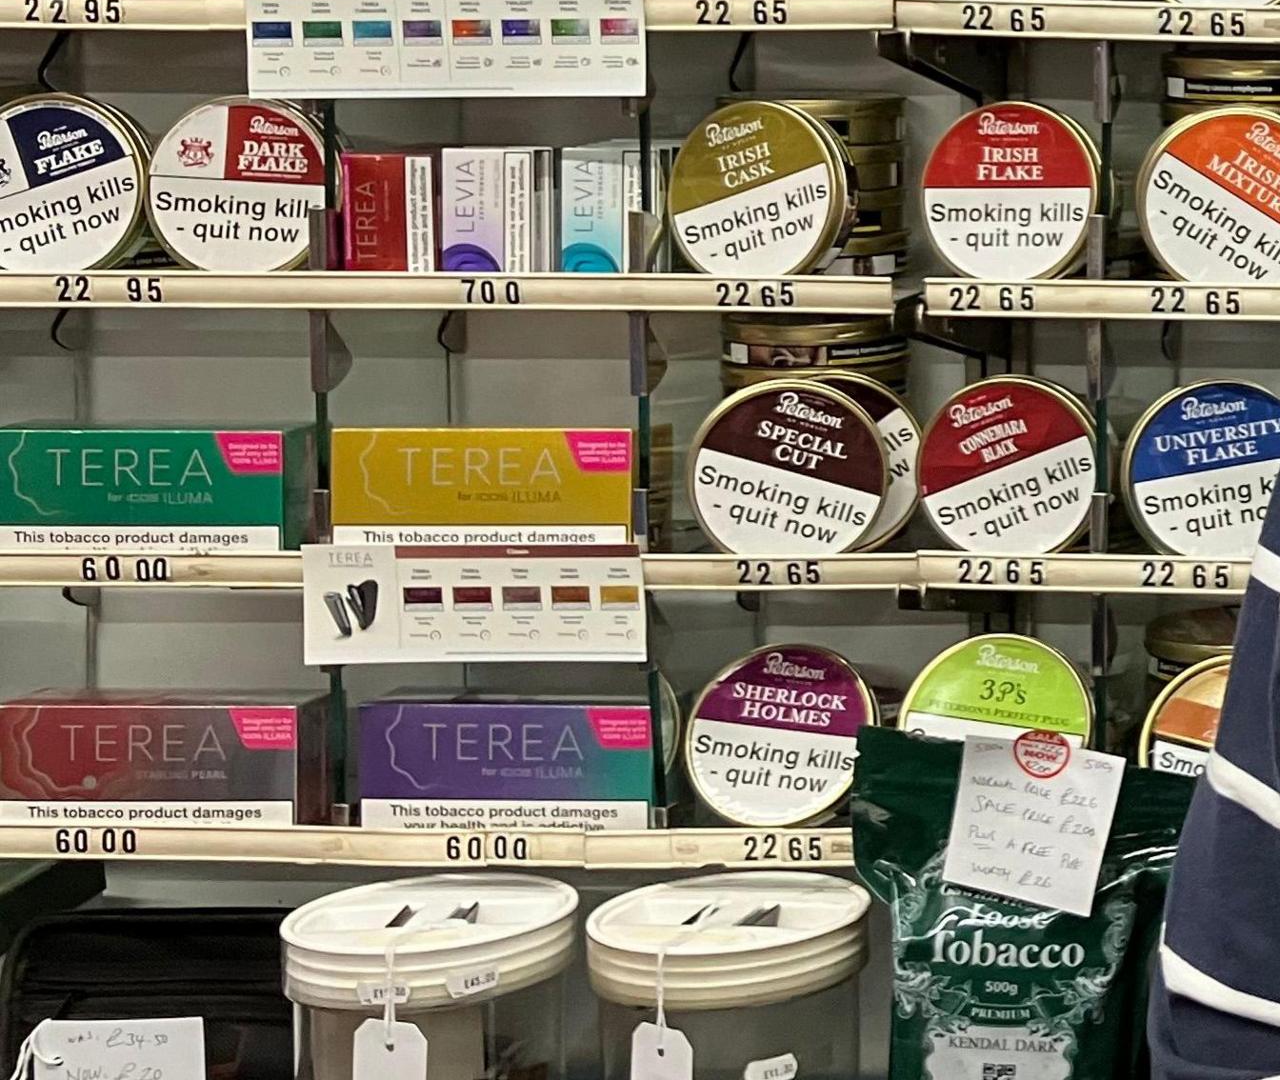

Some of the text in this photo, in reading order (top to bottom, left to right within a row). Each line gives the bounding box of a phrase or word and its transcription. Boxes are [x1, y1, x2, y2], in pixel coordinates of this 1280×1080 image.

[243, 140, 305, 159] DARK
[717, 142, 772, 174] IRISH
[981, 146, 1039, 164] IRISH
[238, 155, 309, 175] FLAKE
[723, 160, 776, 191] CASK
[976, 163, 1044, 182] FLAKE
[758, 421, 847, 460] SPECIAL
[980, 440, 1019, 462] BLACK
[46, 448, 213, 486] TEREA
[773, 443, 824, 470] CUT
[1186, 444, 1258, 466] FLAKE
[13, 531, 249, 547] This tobacco product damages
[732, 681, 847, 711] SHERLOCK
[740, 700, 831, 727] HOLMES
[61, 723, 227, 762] TEREA
[932, 927, 1085, 969] Tobacco
[947, 1034, 1060, 1054] KENDAL DARK
